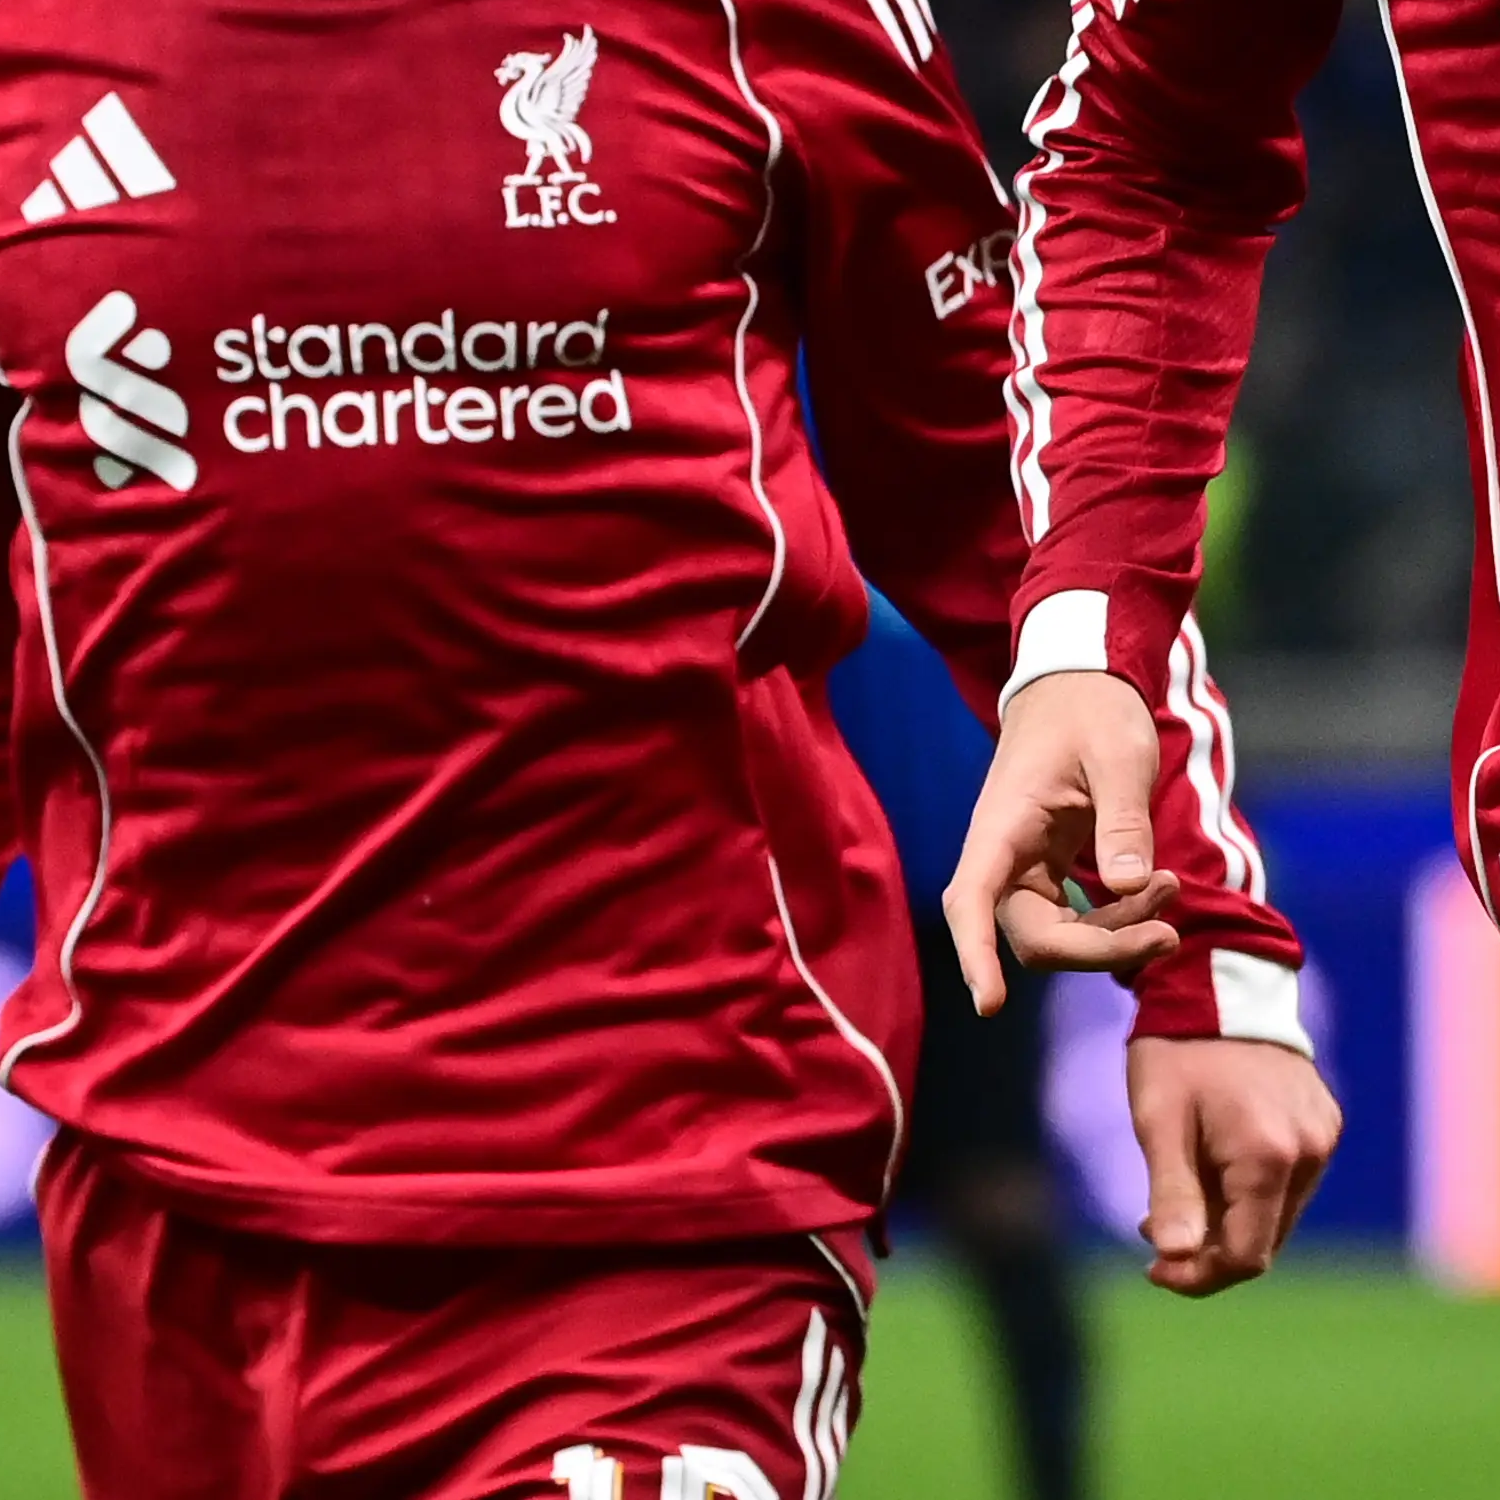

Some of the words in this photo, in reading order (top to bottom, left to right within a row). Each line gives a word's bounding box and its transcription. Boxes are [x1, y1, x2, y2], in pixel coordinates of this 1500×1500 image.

[501, 183, 618, 229] L.F.C.
[213, 308, 609, 383] standard
[223, 368, 633, 453] chartered
